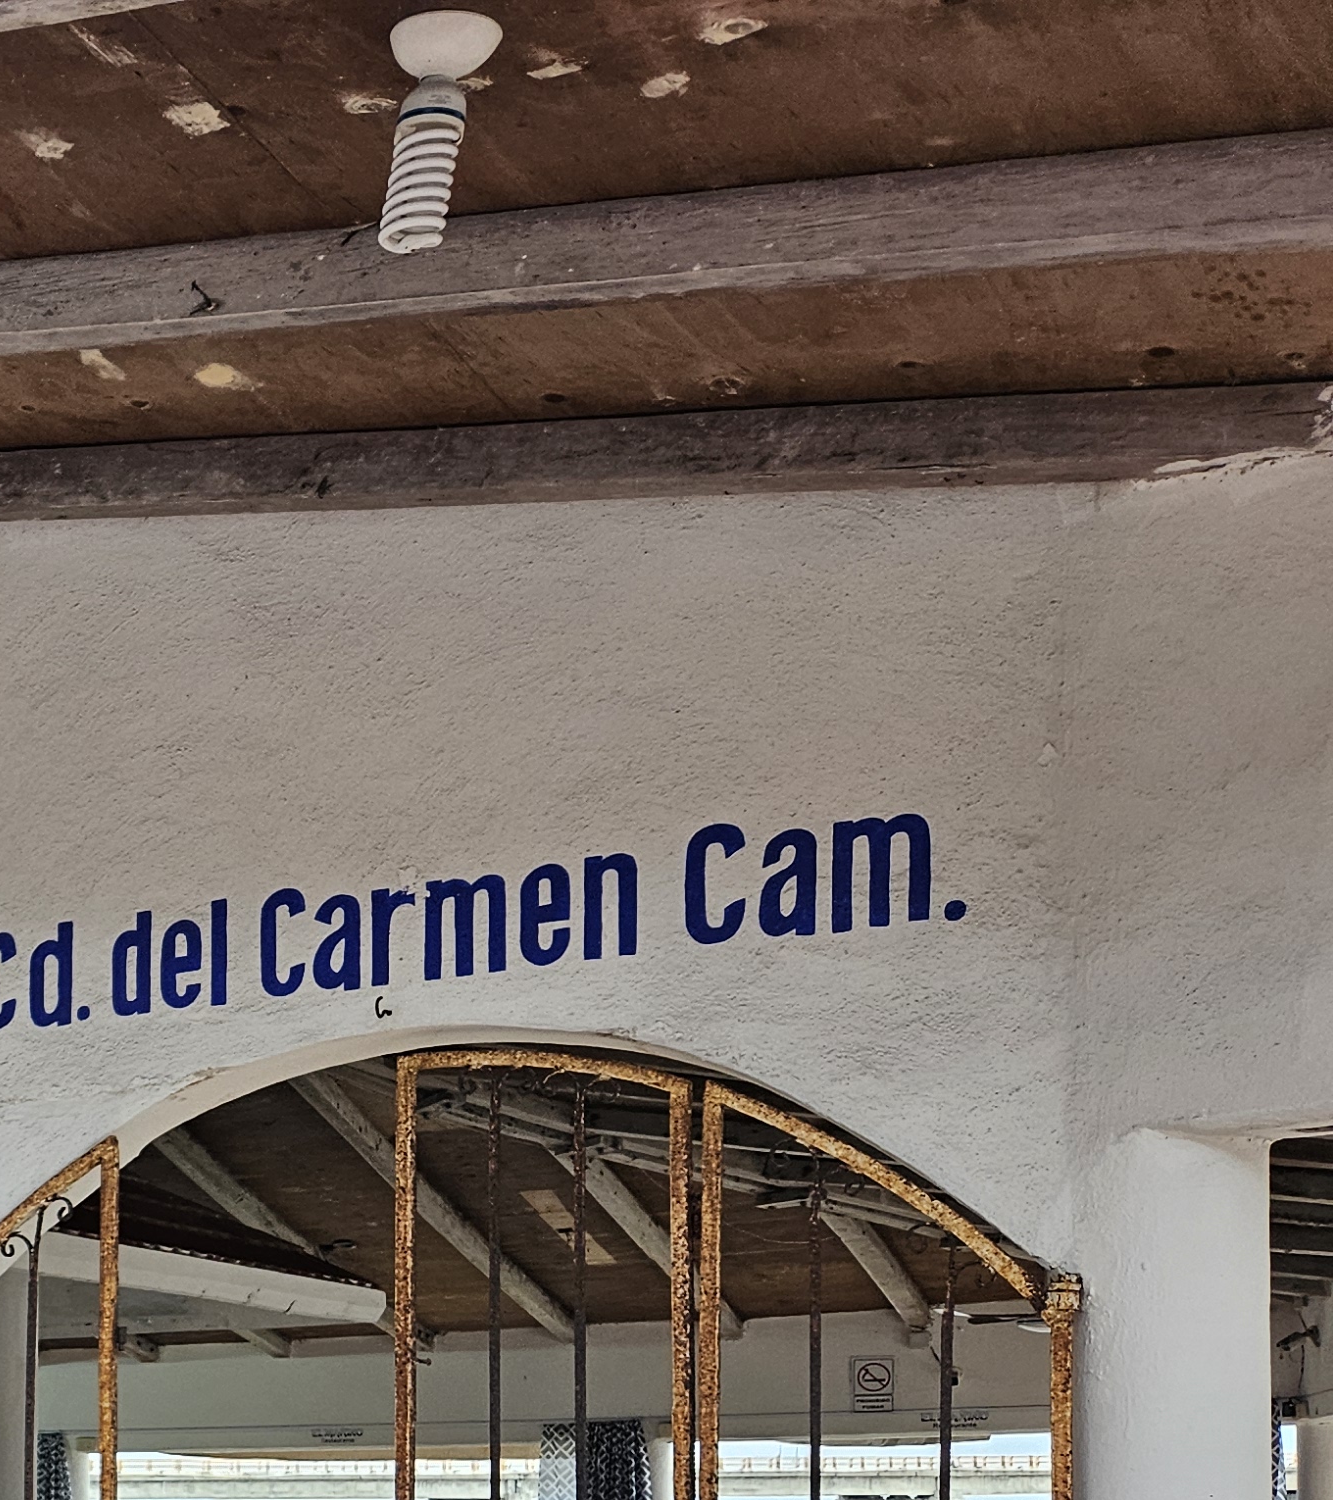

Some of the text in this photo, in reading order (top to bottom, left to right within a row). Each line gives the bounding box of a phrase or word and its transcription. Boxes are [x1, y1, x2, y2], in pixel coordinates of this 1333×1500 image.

[112, 900, 228, 1018] del
[260, 853, 638, 998] Carmen
[685, 813, 968, 945] Cam.
